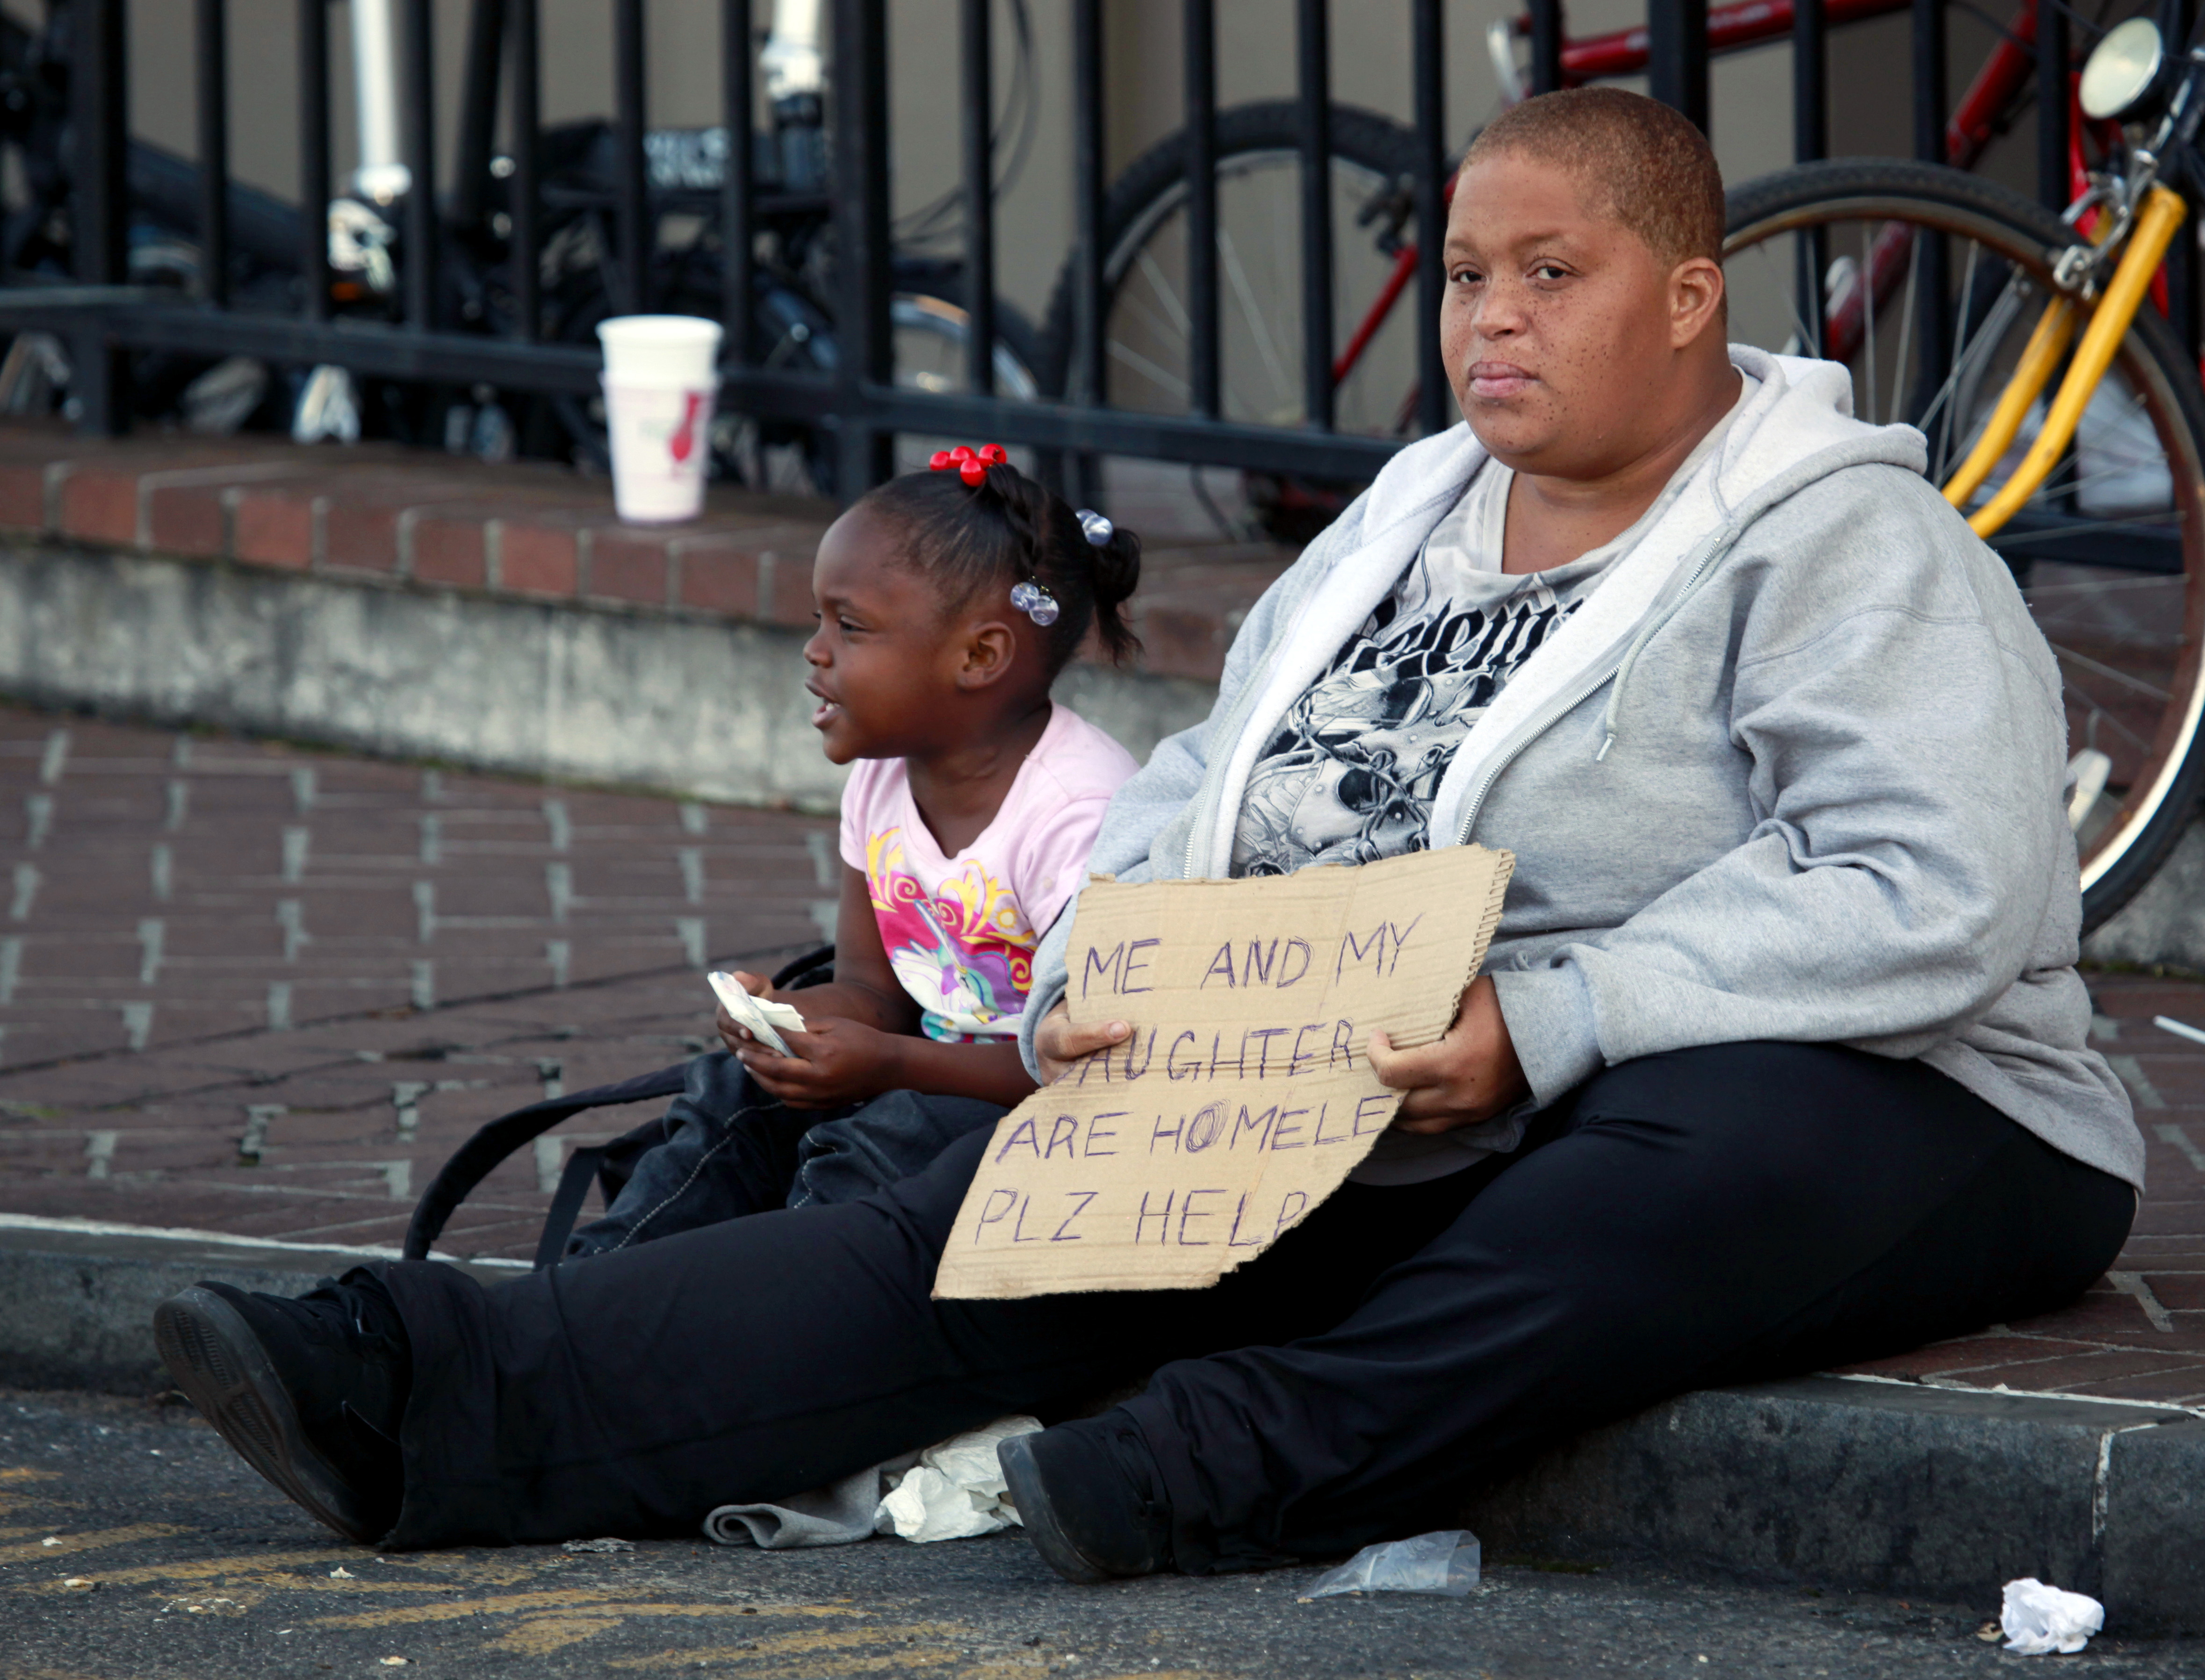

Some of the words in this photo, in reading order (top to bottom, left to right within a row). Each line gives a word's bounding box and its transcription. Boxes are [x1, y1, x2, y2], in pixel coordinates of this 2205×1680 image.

[1082, 938, 1162, 1002] ME
[1200, 934, 1315, 990] AND
[1336, 912, 1426, 987] MY
[1053, 1017, 1354, 1088] AUGHTER
[995, 1112, 1134, 1165] ARE
[1150, 1095, 1404, 1156] HOMELE
[974, 1188, 1099, 1245] PLZ
[1135, 1189, 1310, 1246] HELP
